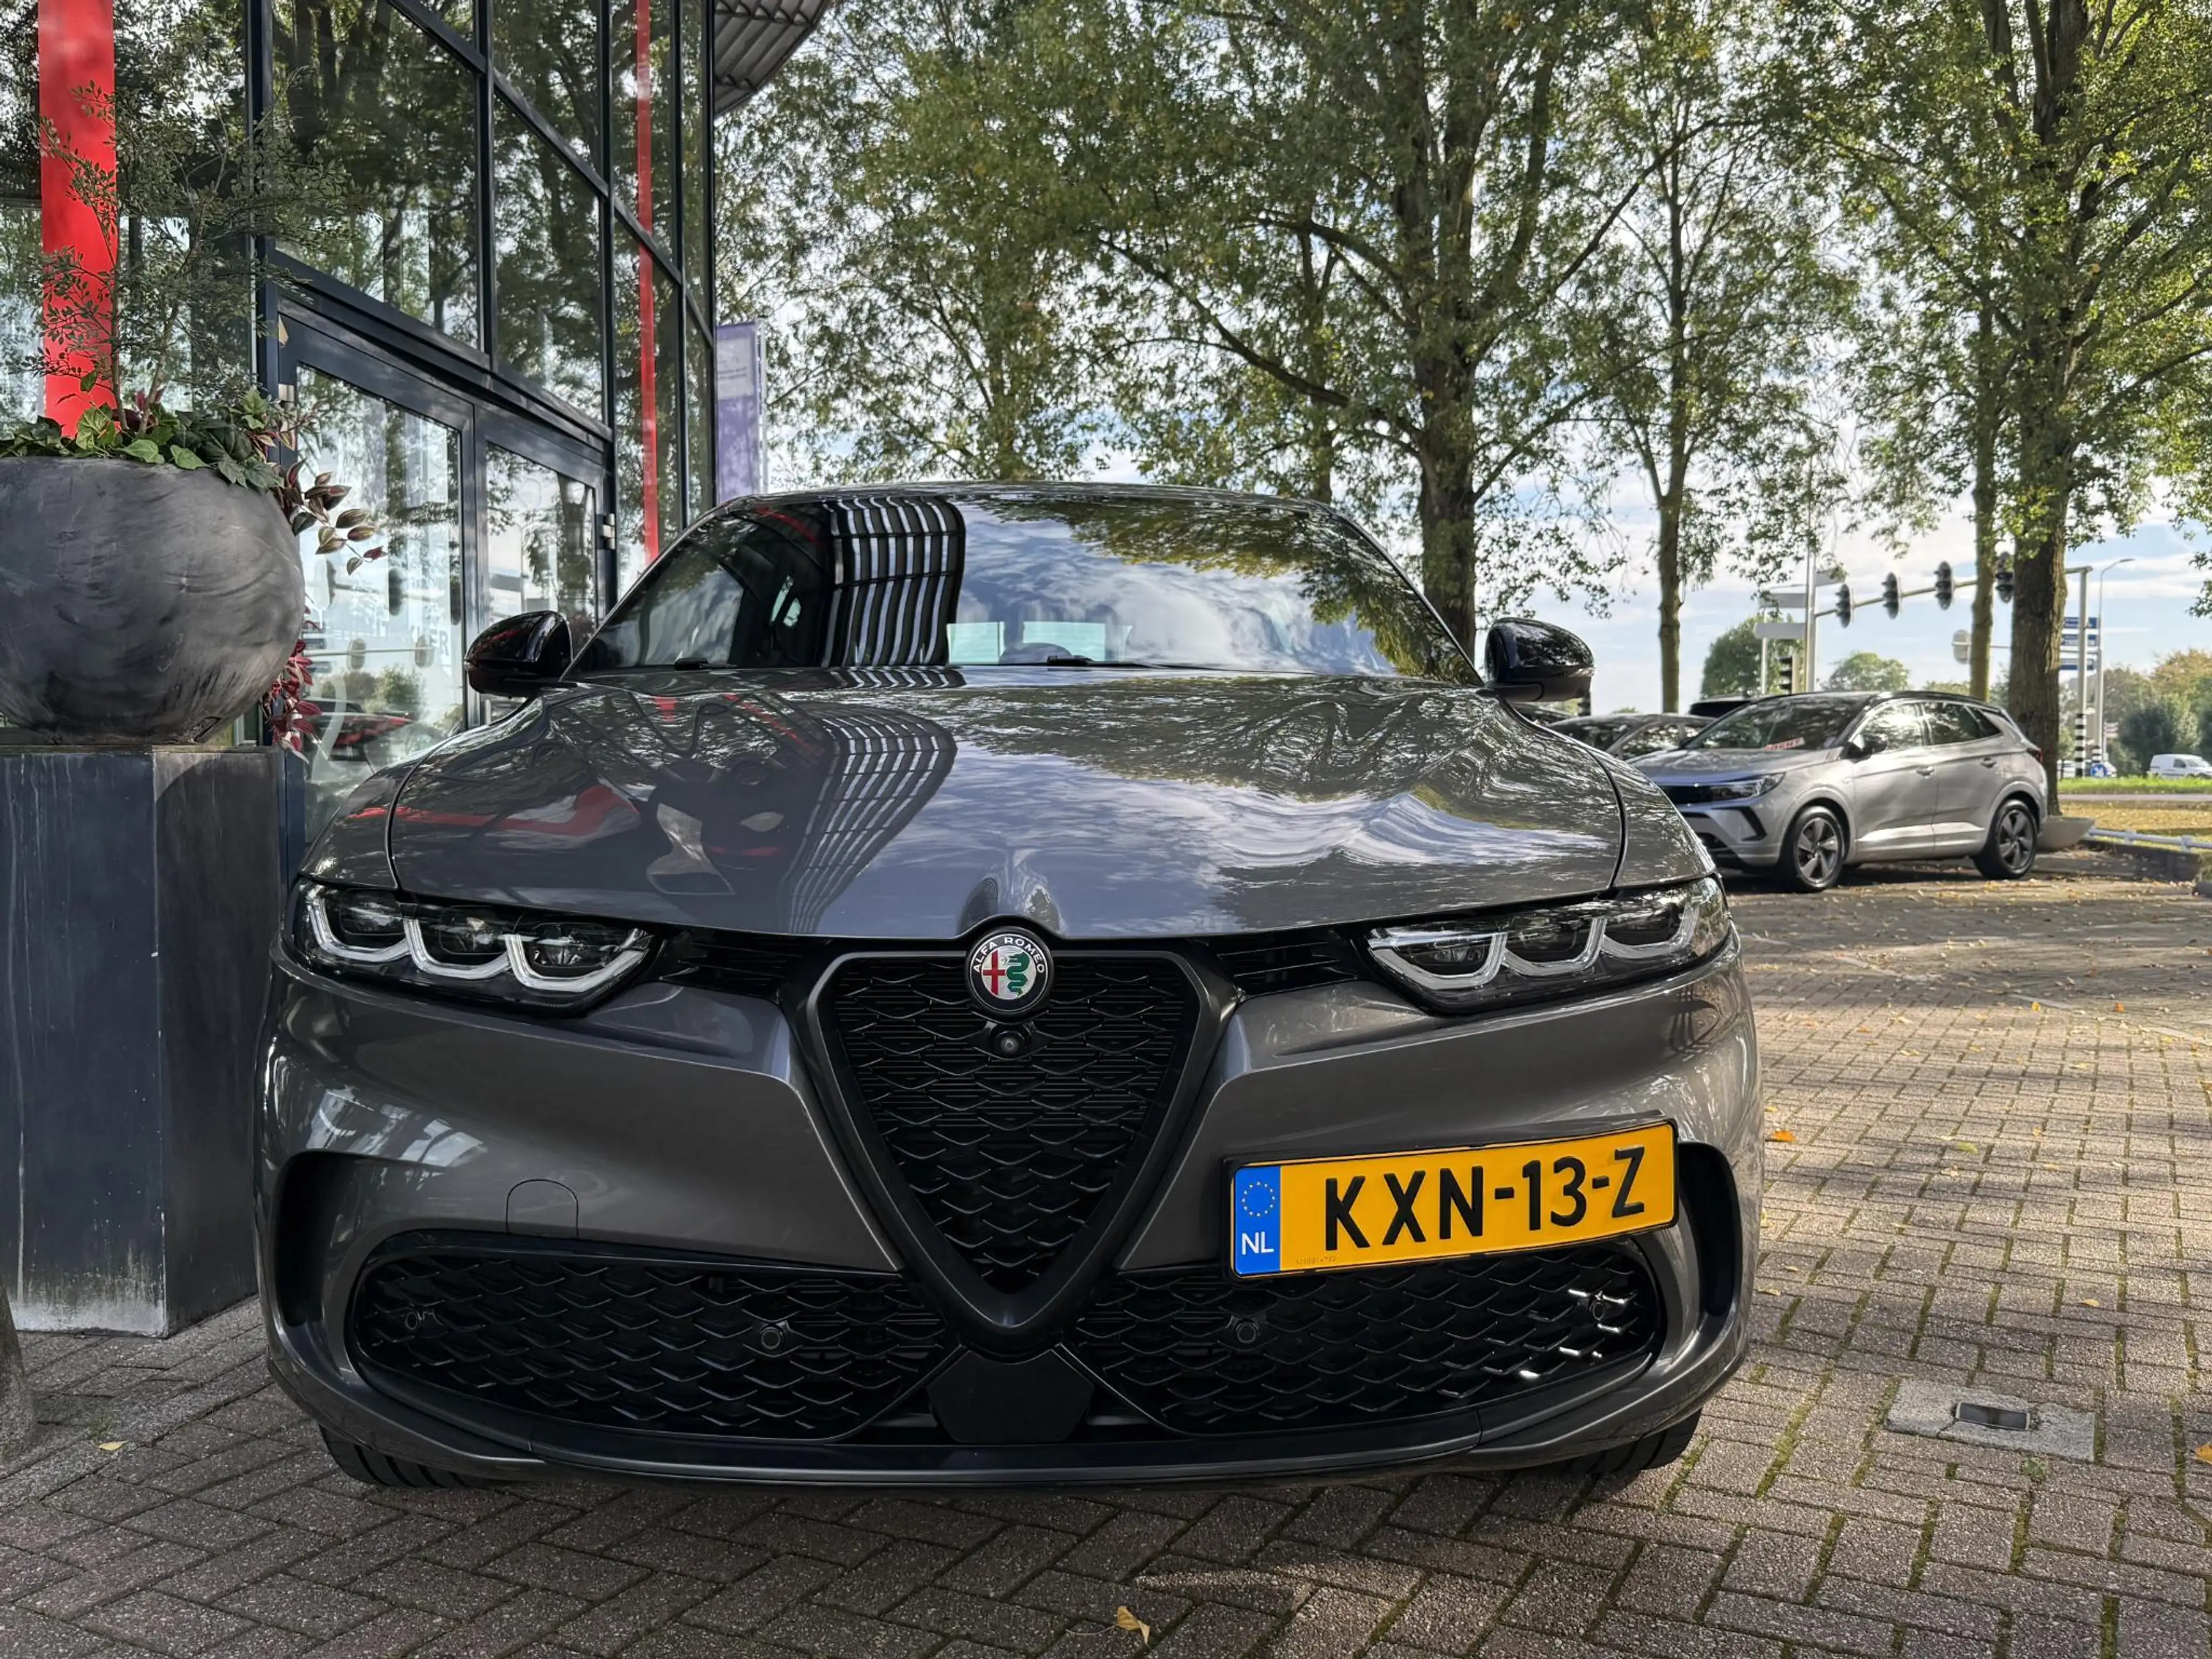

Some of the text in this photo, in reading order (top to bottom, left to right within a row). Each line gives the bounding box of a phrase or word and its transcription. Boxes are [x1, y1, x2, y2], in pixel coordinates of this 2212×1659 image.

[974, 937, 1044, 973] ALFA ROMEO
[1325, 1146, 1645, 1251] KXN-13-Z
[1241, 1231, 1274, 1255] NL
